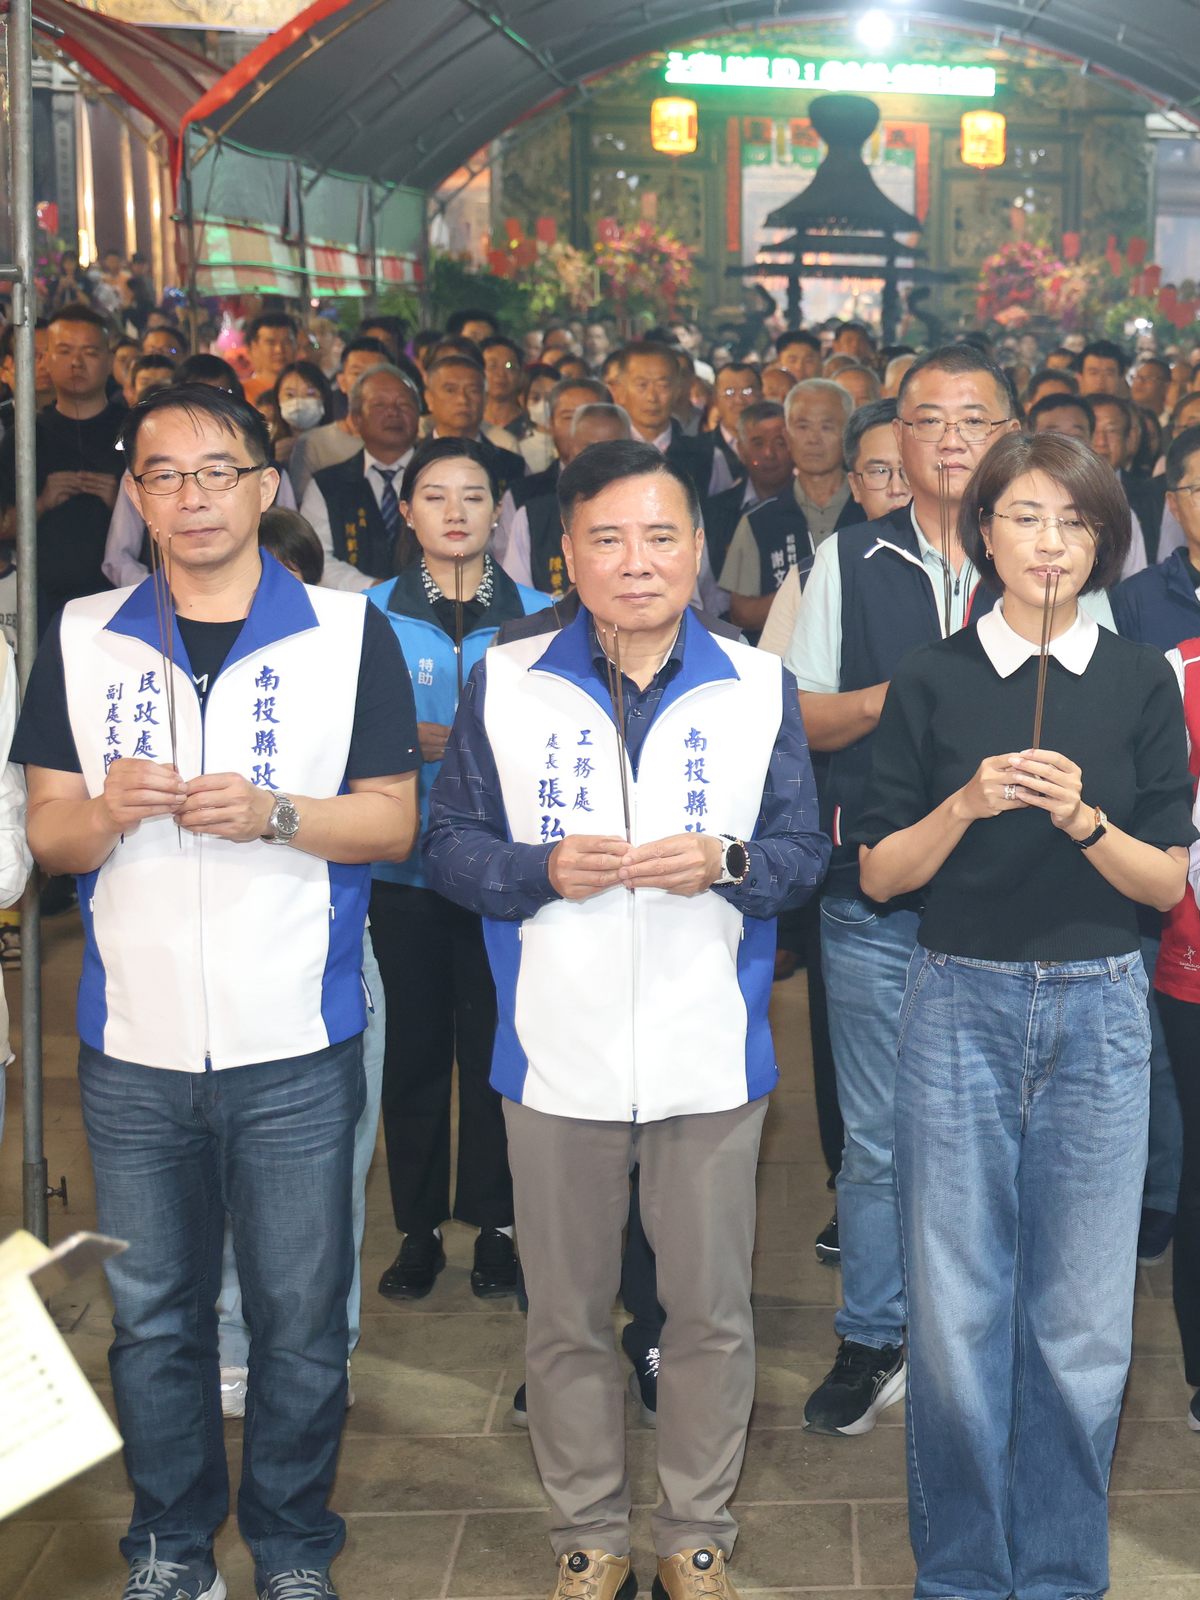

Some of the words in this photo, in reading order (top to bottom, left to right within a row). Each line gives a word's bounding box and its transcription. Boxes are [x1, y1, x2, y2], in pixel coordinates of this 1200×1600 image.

[133, 670, 161, 758] 民政處
[572, 729, 596, 812] 工務處
